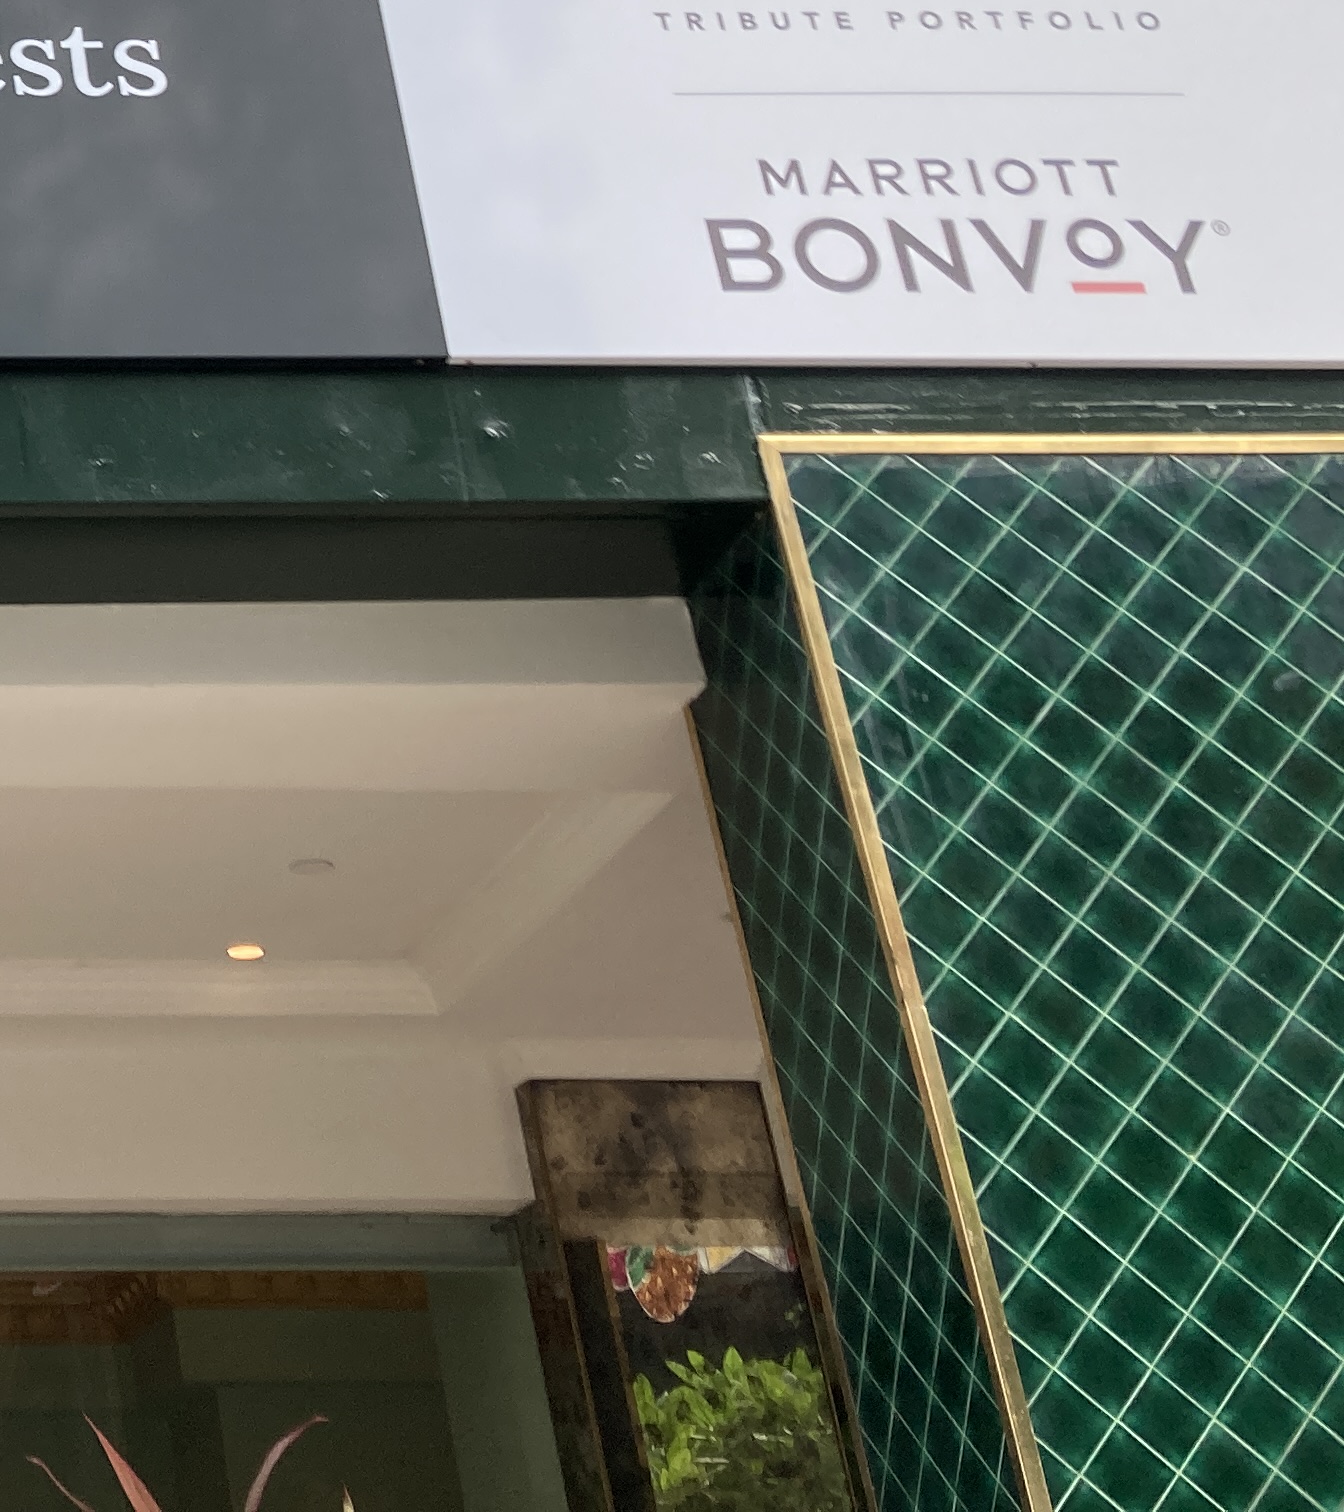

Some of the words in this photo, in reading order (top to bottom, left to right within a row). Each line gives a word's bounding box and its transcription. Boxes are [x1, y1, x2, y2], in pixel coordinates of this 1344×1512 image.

[653, 10, 855, 32] TRIBUTE
[884, 9, 1163, 32] PORTFOLIO
[757, 157, 1120, 198] MARRIOTT
